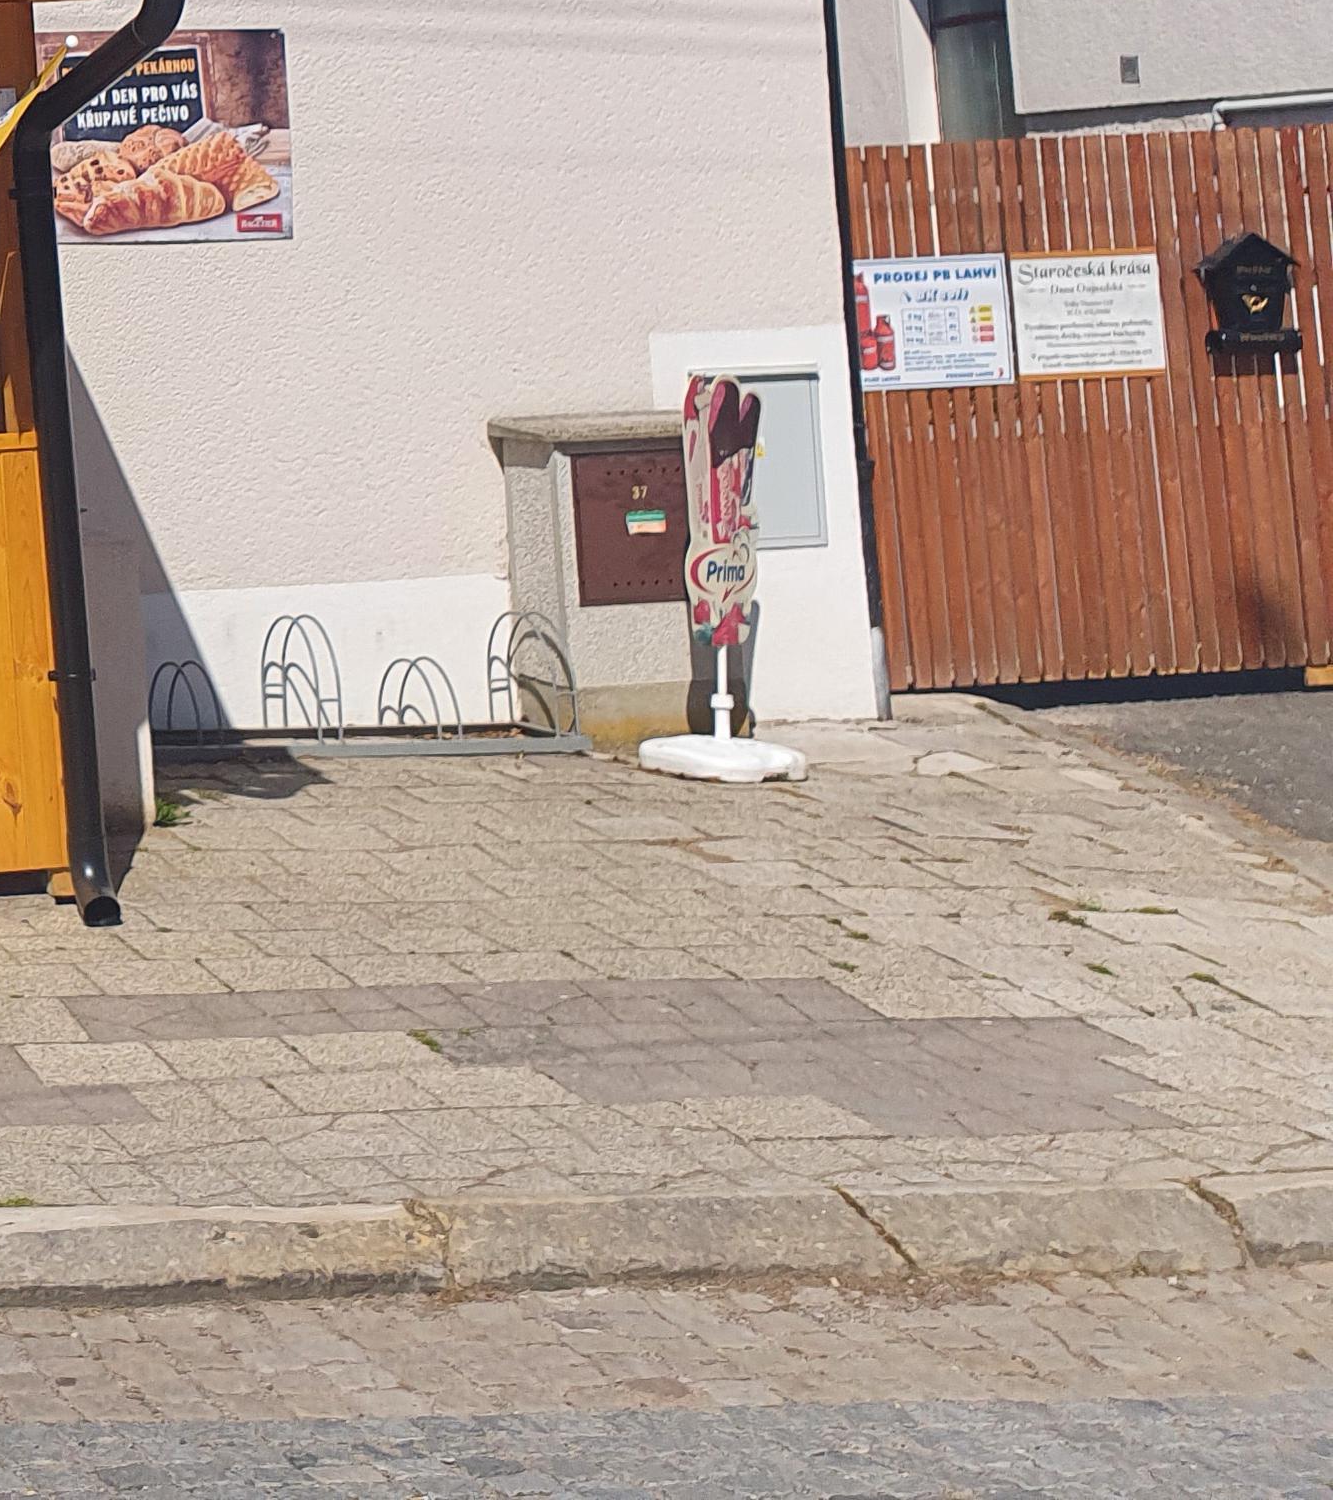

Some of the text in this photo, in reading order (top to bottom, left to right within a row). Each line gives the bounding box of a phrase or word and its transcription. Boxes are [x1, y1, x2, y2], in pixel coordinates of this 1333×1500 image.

[135, 57, 196, 77] PEKÁRNOU
[112, 86, 138, 105] DEN
[141, 84, 168, 104] PRO
[171, 80, 198, 101] VÁS
[76, 104, 190, 129] KŘUPAVÉ PEČIVO
[873, 269, 929, 284] PRODEJ
[1017, 259, 1152, 286] Staročeská krása
[706, 560, 746, 584] Prima
